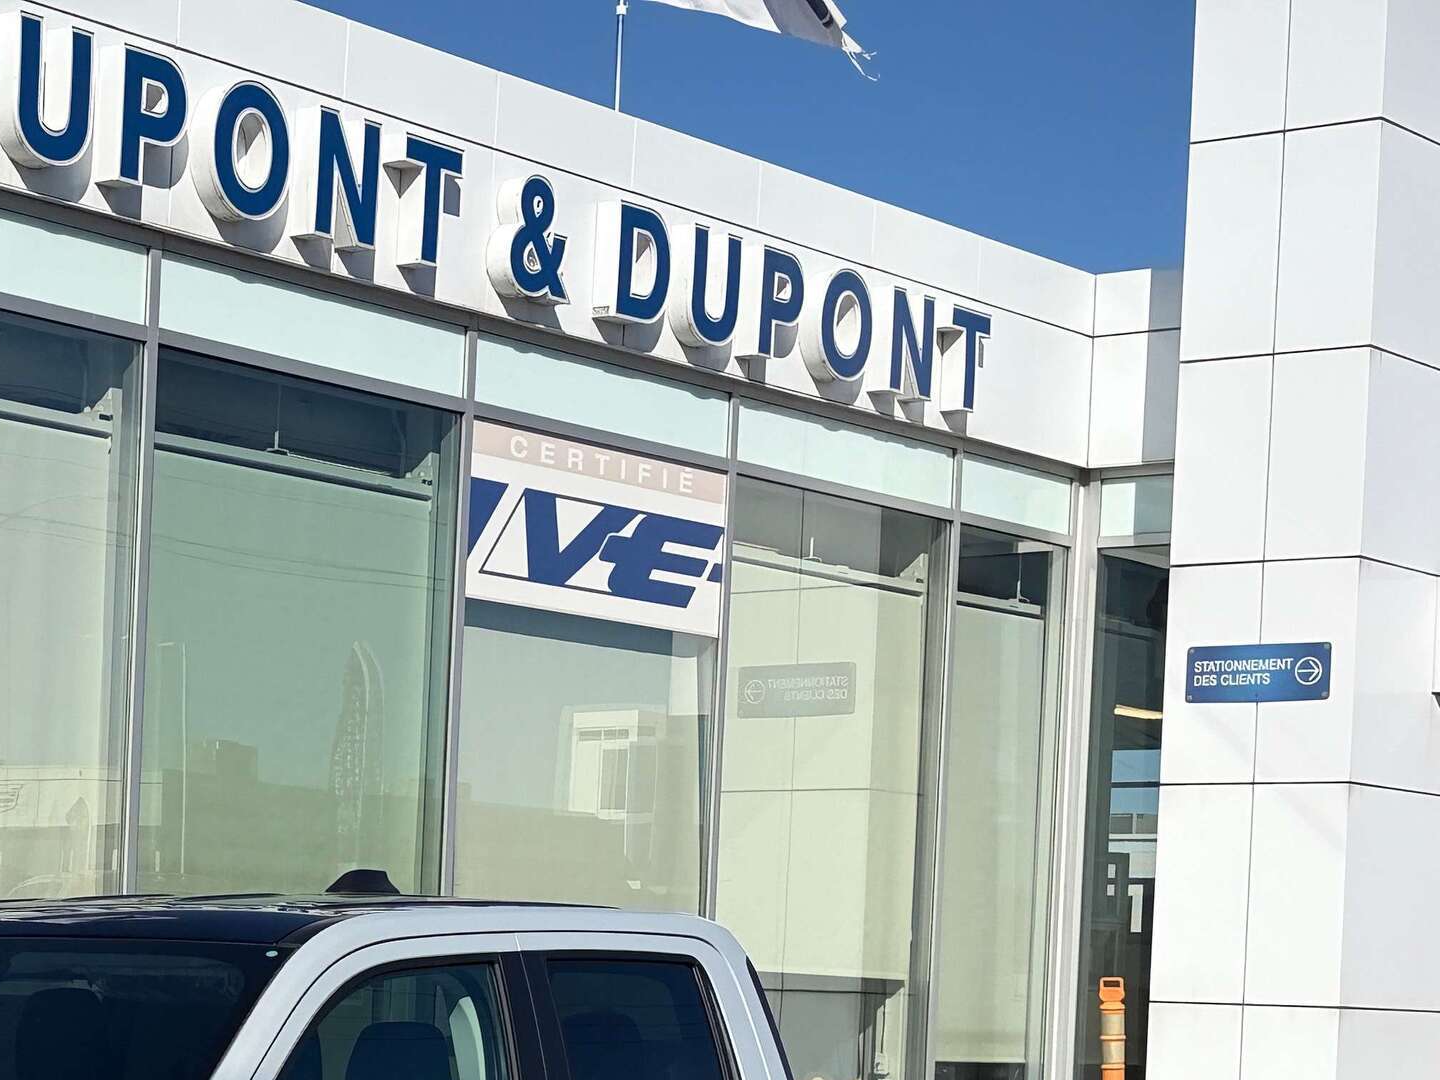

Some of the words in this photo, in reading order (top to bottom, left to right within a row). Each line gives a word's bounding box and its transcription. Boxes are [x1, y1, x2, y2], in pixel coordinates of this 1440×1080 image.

[509, 174, 569, 304] &
[615, 199, 991, 412] DUPONT
[510, 435, 695, 494] CERTIFIÉ
[1194, 658, 1293, 673] STATIONNEMENT
[1194, 674, 1217, 687] DES
[1220, 673, 1271, 686] CLIENTS
